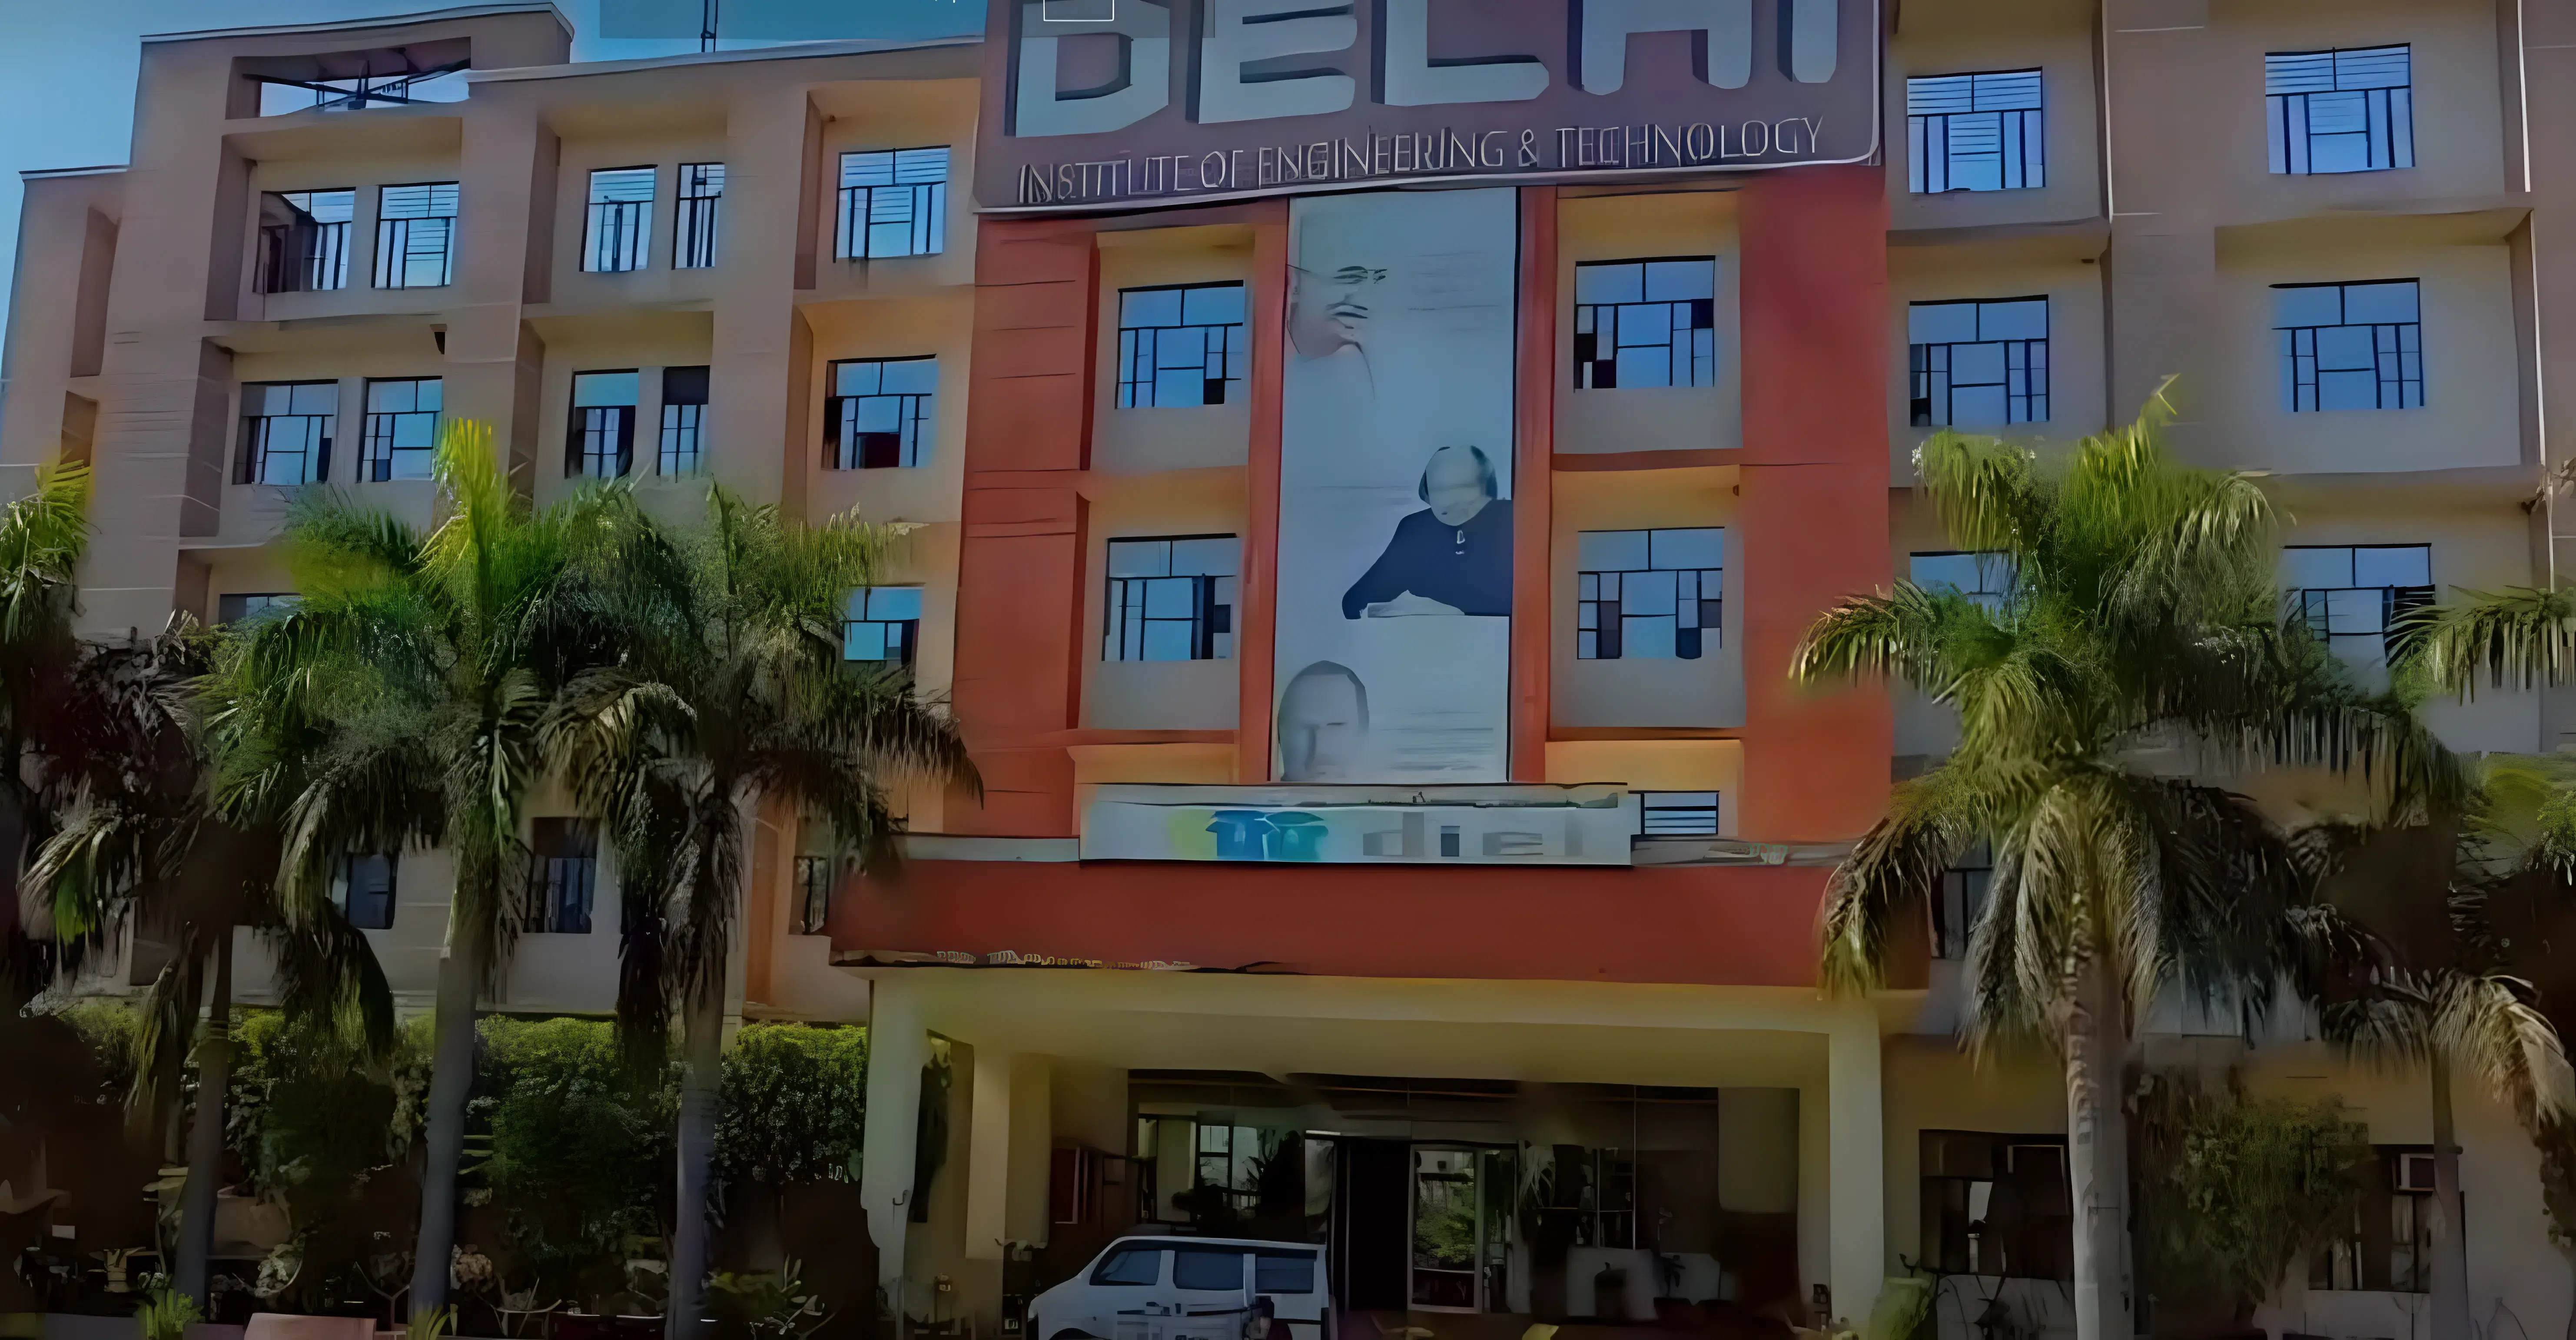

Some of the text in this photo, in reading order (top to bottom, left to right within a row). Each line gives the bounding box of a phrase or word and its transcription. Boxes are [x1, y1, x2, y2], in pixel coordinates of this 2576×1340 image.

[1201, 150, 1244, 188] OF
[1258, 126, 1507, 186] ENGINEERING
[1518, 129, 1538, 167] &
[1555, 114, 1824, 168] TECHNOLOGY
